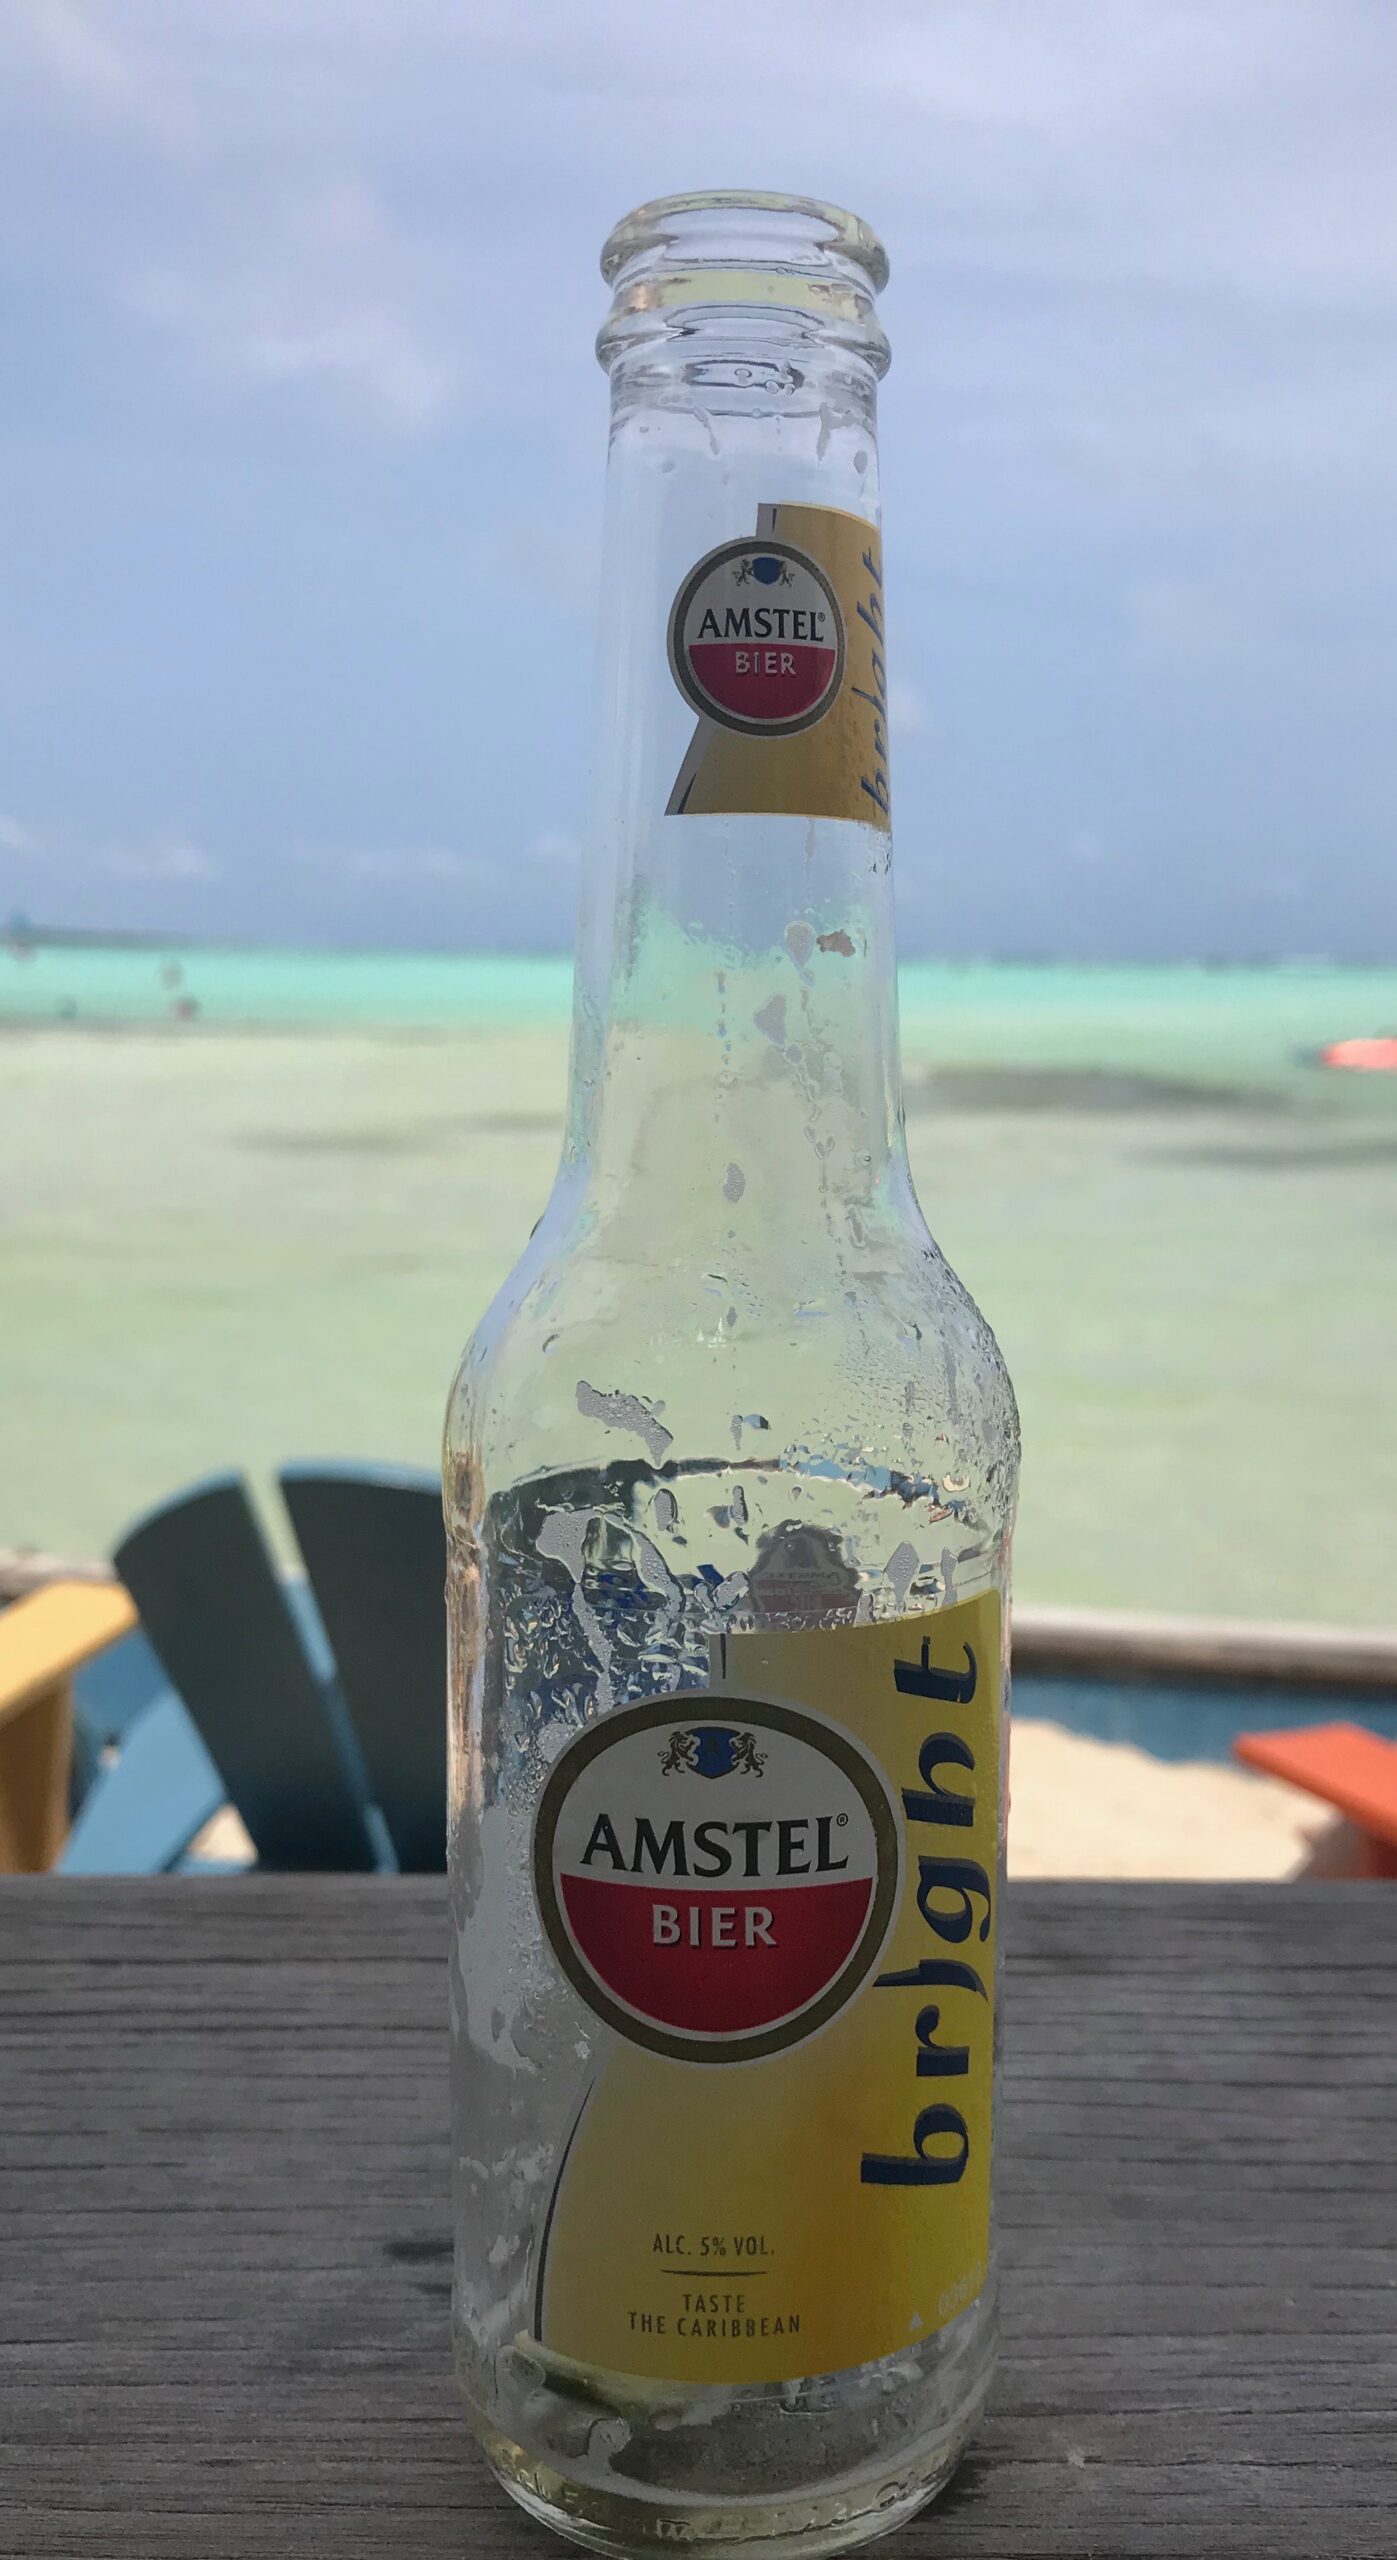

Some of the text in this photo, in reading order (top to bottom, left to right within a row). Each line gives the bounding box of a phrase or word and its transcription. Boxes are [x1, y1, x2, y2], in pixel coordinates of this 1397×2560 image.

[735, 651, 797, 676] BIER
[860, 1636, 991, 2186] bright
[652, 1904, 778, 1948] BIER
[653, 2233, 775, 2257] ALC. 5% VOL.
[682, 2294, 746, 2314] TASTE
[628, 2312, 801, 2338] THE CARIBBEAN
